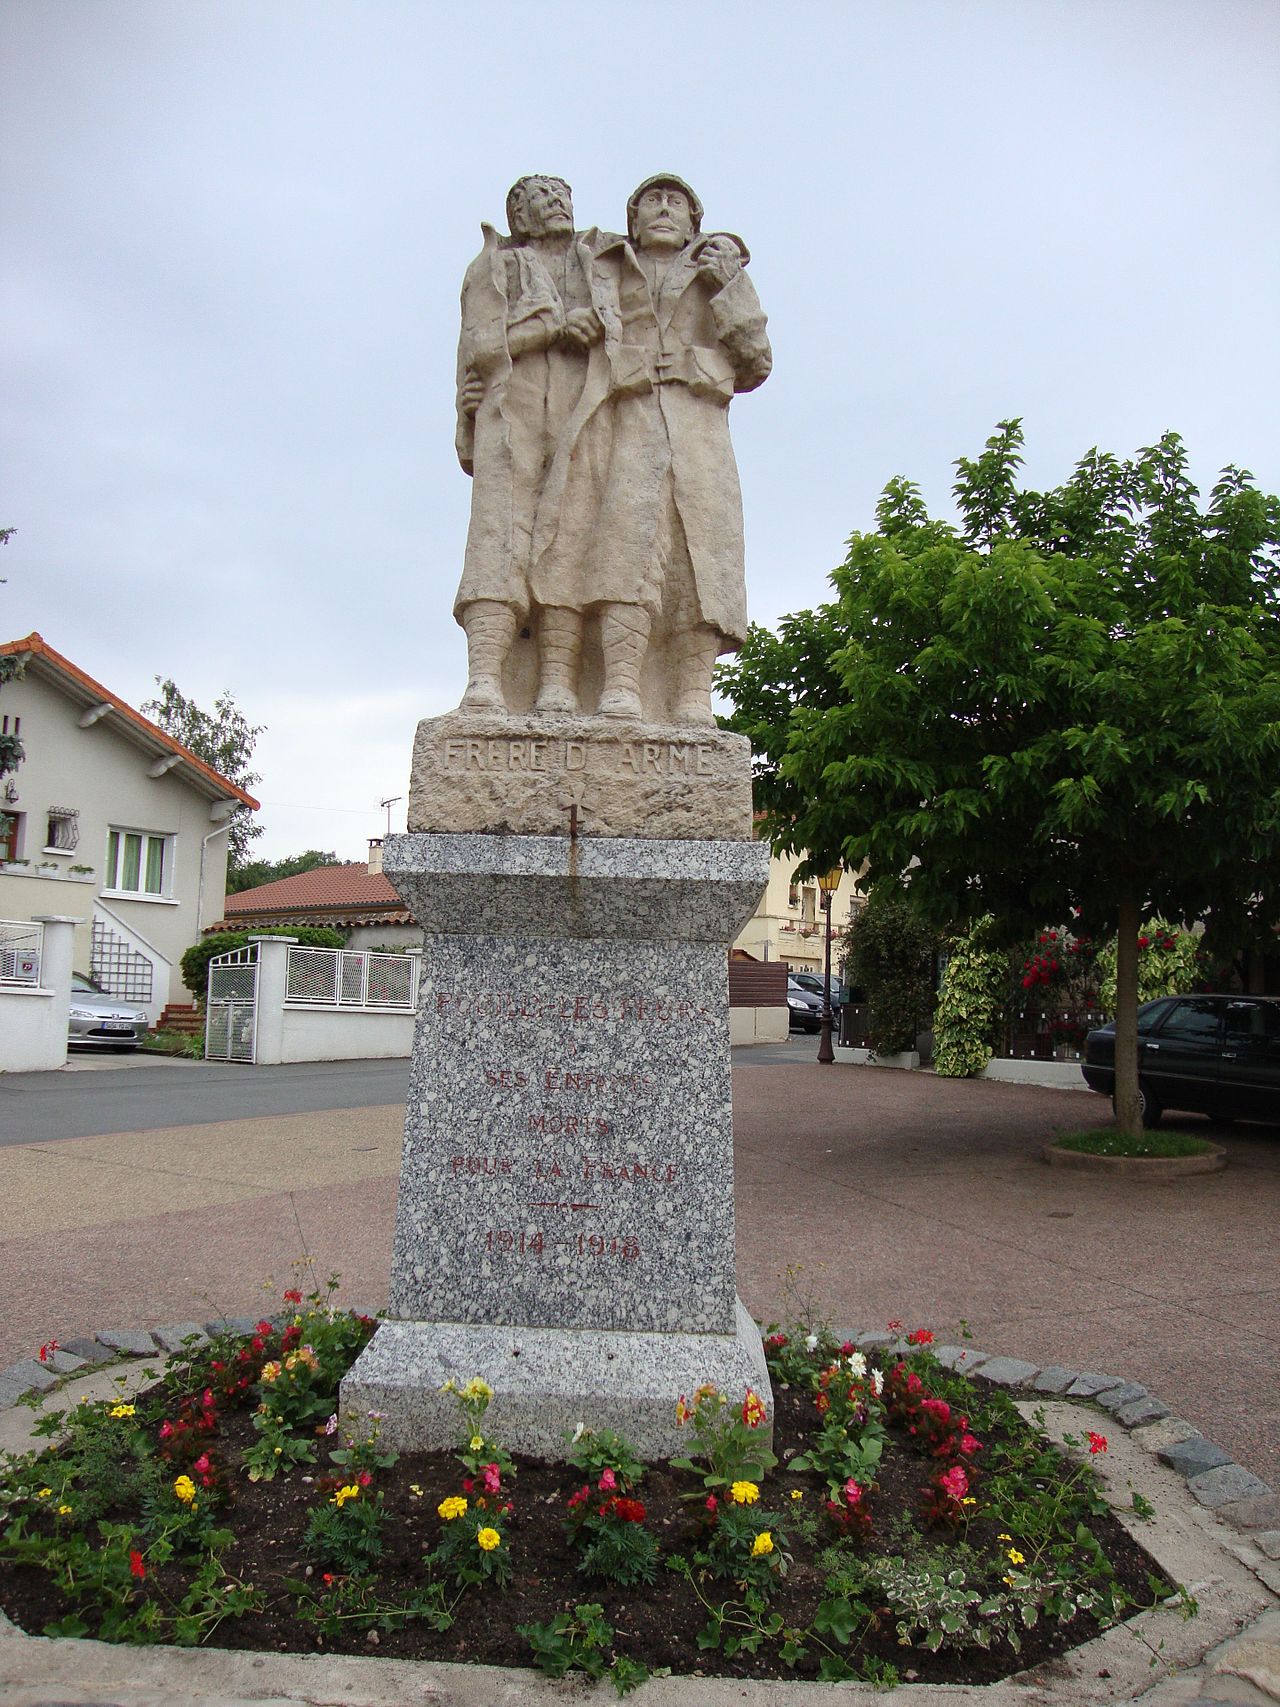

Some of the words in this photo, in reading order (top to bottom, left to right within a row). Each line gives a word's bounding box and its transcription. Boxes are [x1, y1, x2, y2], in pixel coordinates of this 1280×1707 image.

[615, 743, 713, 776] ARME
[484, 1070, 527, 1089] SES
[528, 1115, 609, 1136] MORTS
[451, 1156, 513, 1176] POUR
[534, 1157, 563, 1180] LA
[582, 1155, 681, 1184] FRANCE
